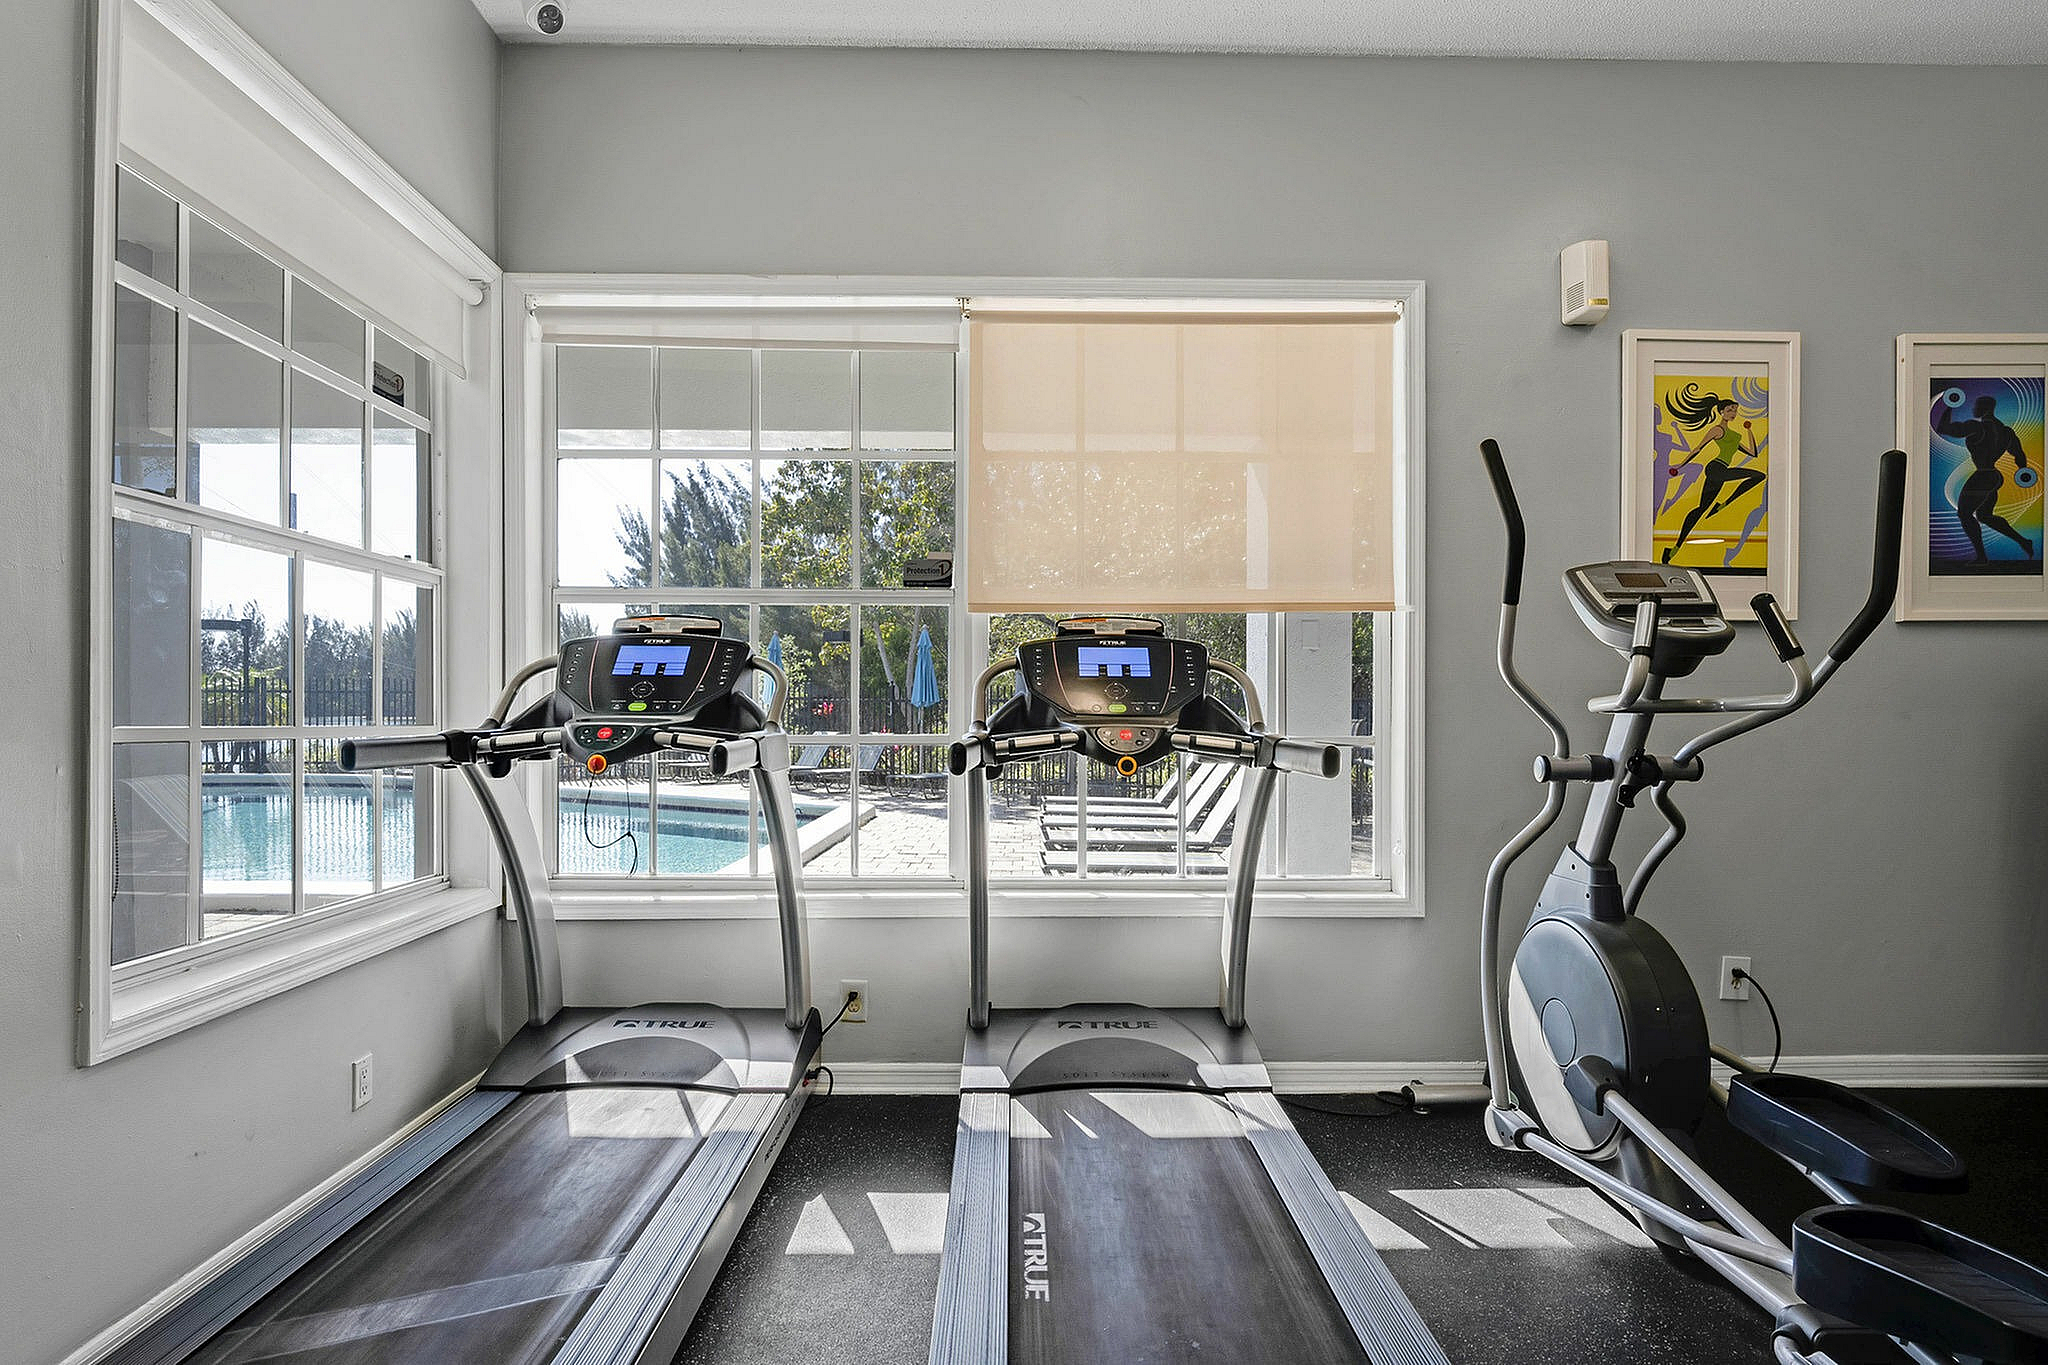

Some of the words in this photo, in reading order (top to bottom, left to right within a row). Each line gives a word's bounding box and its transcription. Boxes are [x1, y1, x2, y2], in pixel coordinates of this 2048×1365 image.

[643, 1020, 716, 1029] TRUE
[1084, 1020, 1160, 1029] TRUE
[1023, 1233, 1050, 1302] TRUE
